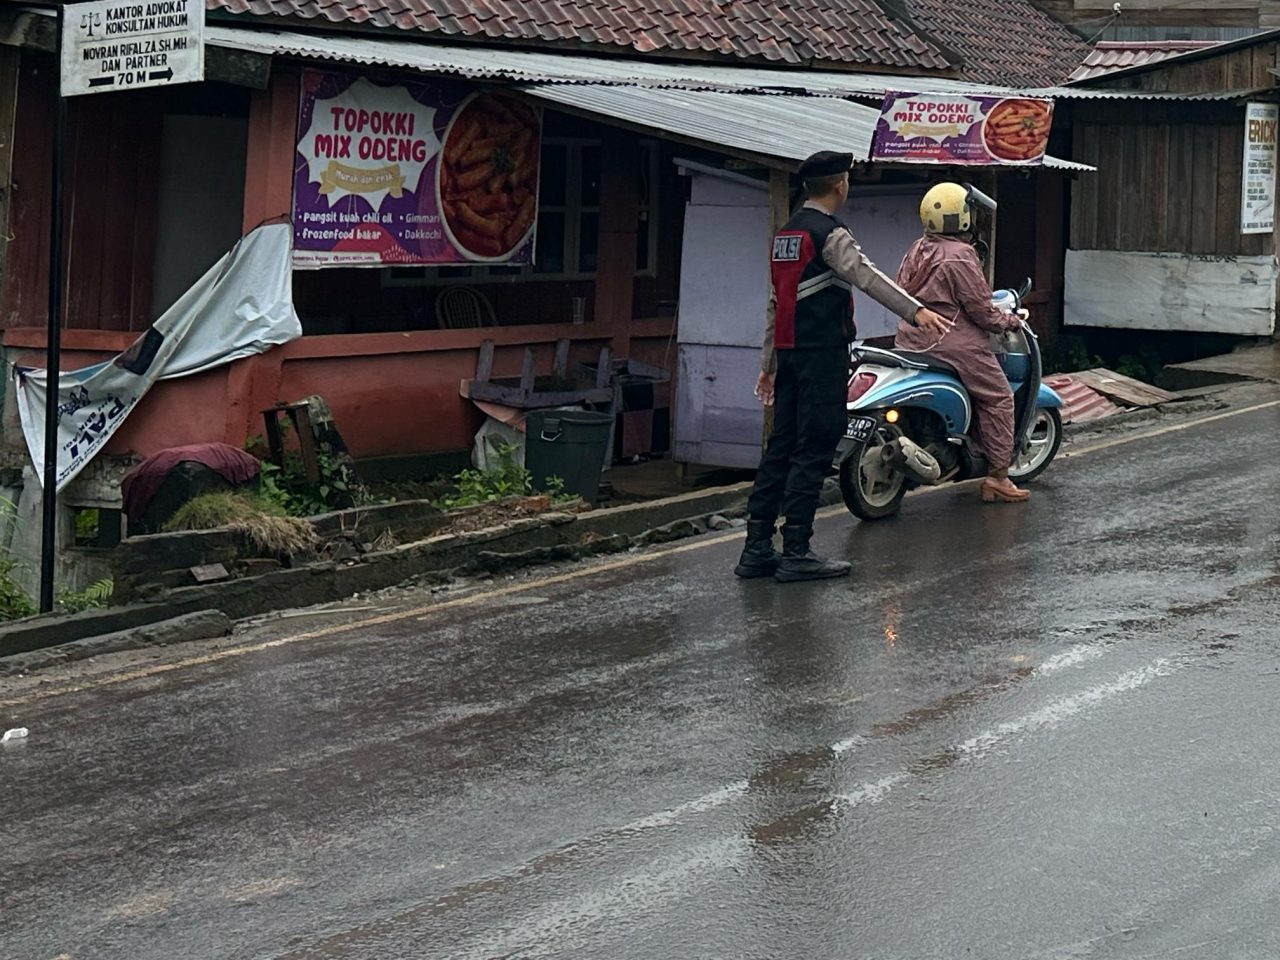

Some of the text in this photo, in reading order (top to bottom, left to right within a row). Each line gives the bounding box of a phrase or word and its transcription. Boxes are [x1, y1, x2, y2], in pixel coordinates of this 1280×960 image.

[107, 0, 188, 21] KANTOR ADVOKAT
[106, 14, 188, 35] KONSULTAN HUKUM
[83, 45, 118, 61] NOVRAN
[101, 53, 167, 73] DAN PARTNER
[118, 71, 146, 85] 70 M
[906, 101, 969, 113] TOPOKKI
[331, 107, 415, 137] TOPOKKI
[894, 112, 974, 124] MIX ODENG
[1248, 120, 1277, 143] ERICK
[315, 134, 426, 163] MIX ODENG
[339, 212, 360, 223] kuah
[362, 212, 380, 223] chili
[405, 213, 440, 223] Gimmari
[356, 229, 382, 240] bakar
[405, 229, 441, 240] Dakkochi
[775, 238, 801, 258] POLISI
[70, 397, 125, 460] PALI
